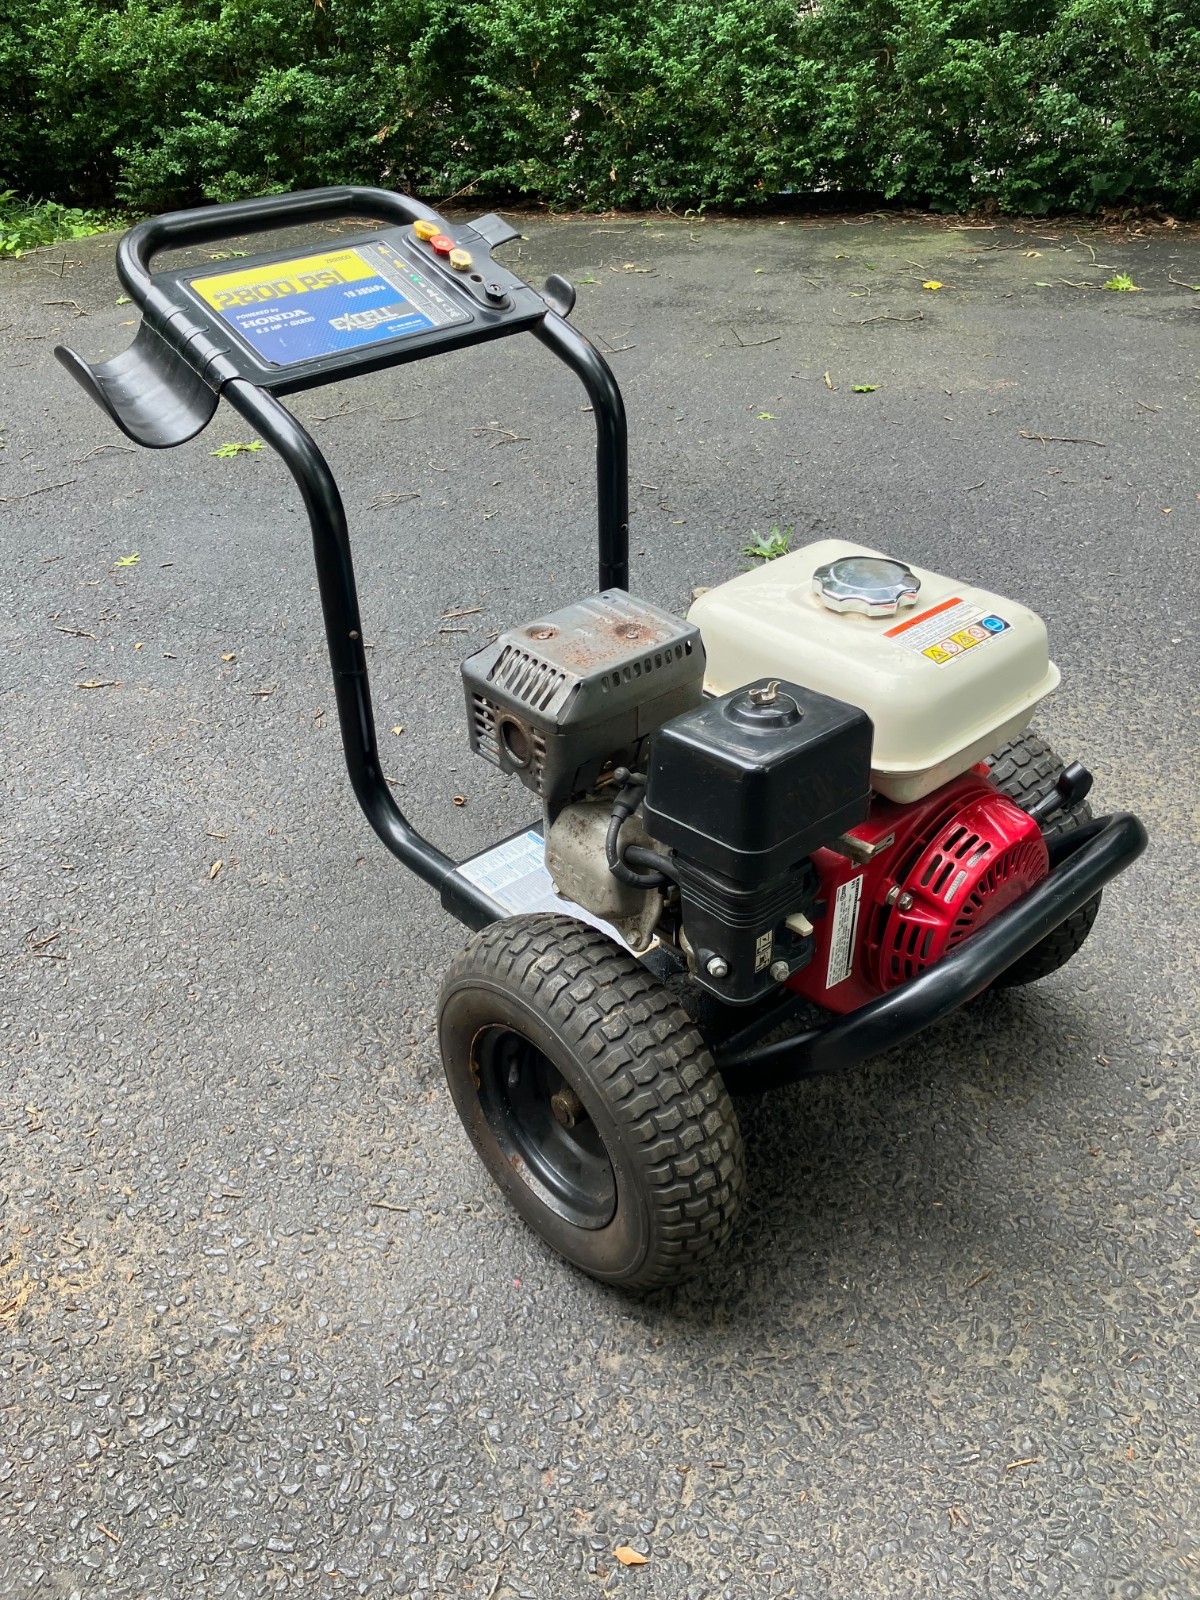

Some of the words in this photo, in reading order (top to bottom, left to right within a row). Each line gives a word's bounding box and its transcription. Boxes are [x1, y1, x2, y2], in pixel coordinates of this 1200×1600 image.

[213, 280, 298, 309] 2800
[300, 269, 350, 291] PSI
[236, 310, 270, 320] POWERED
[240, 309, 309, 329] HONDA
[256, 326, 270, 334] 6.5
[290, 316, 316, 326] GX200
[328, 306, 399, 331] EXCELL
